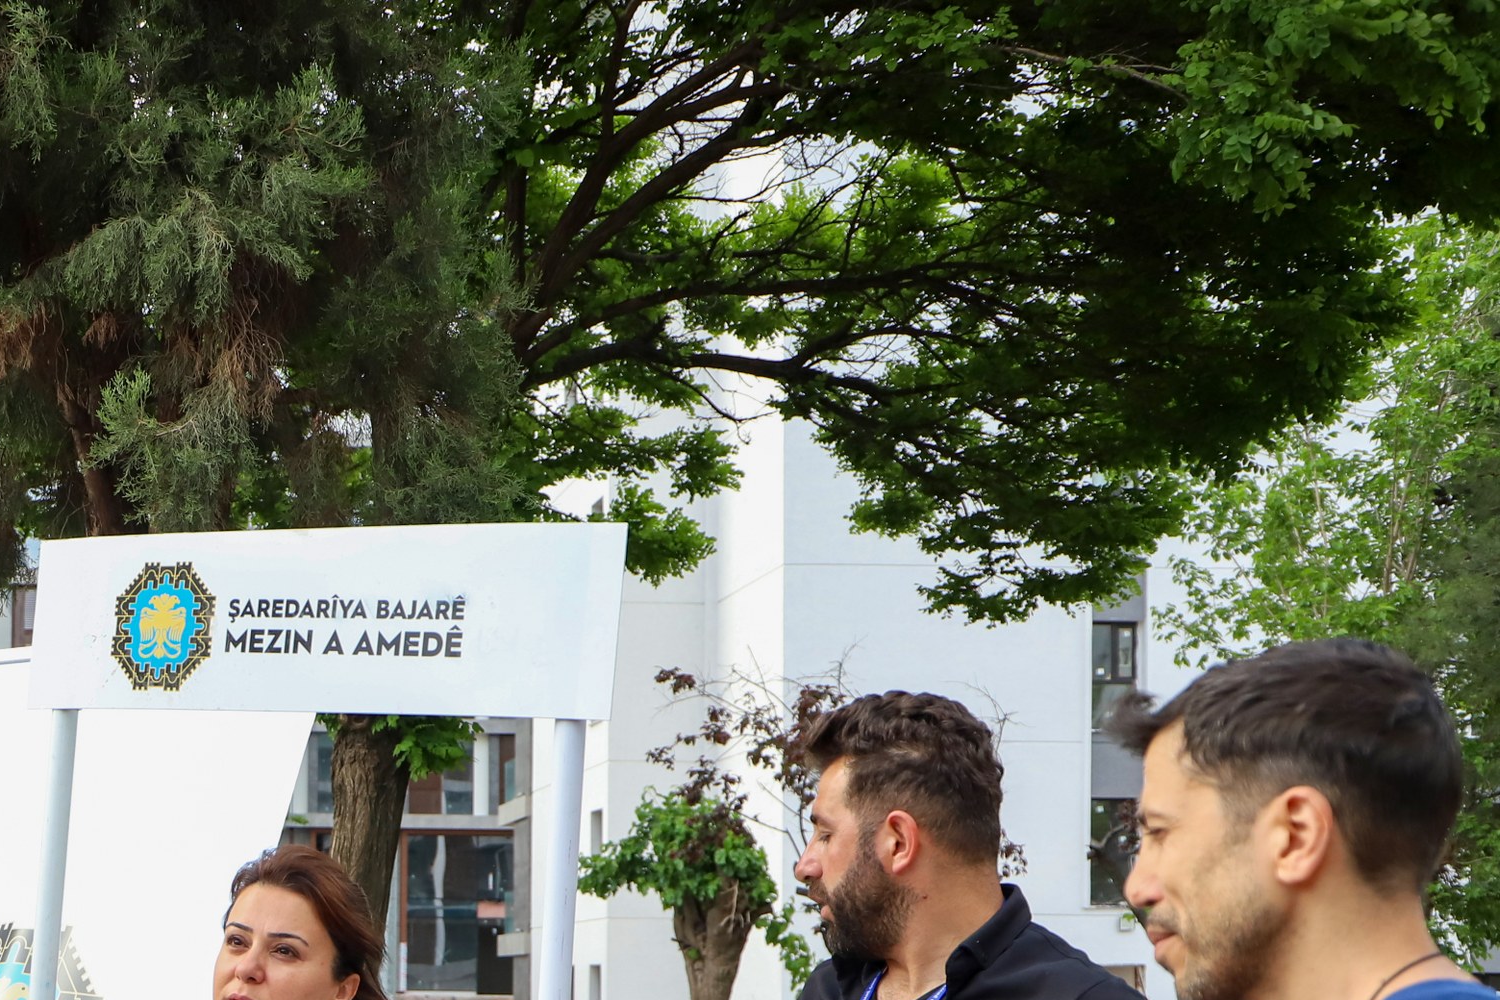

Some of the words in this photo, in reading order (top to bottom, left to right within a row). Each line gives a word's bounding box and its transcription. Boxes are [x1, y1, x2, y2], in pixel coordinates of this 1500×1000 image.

[228, 594, 367, 623] ŞAREDARÎYA
[376, 595, 466, 620] BAJARÊ
[224, 628, 313, 654] MEZIN
[322, 629, 345, 655] A
[352, 624, 464, 658] AMEDÊ
